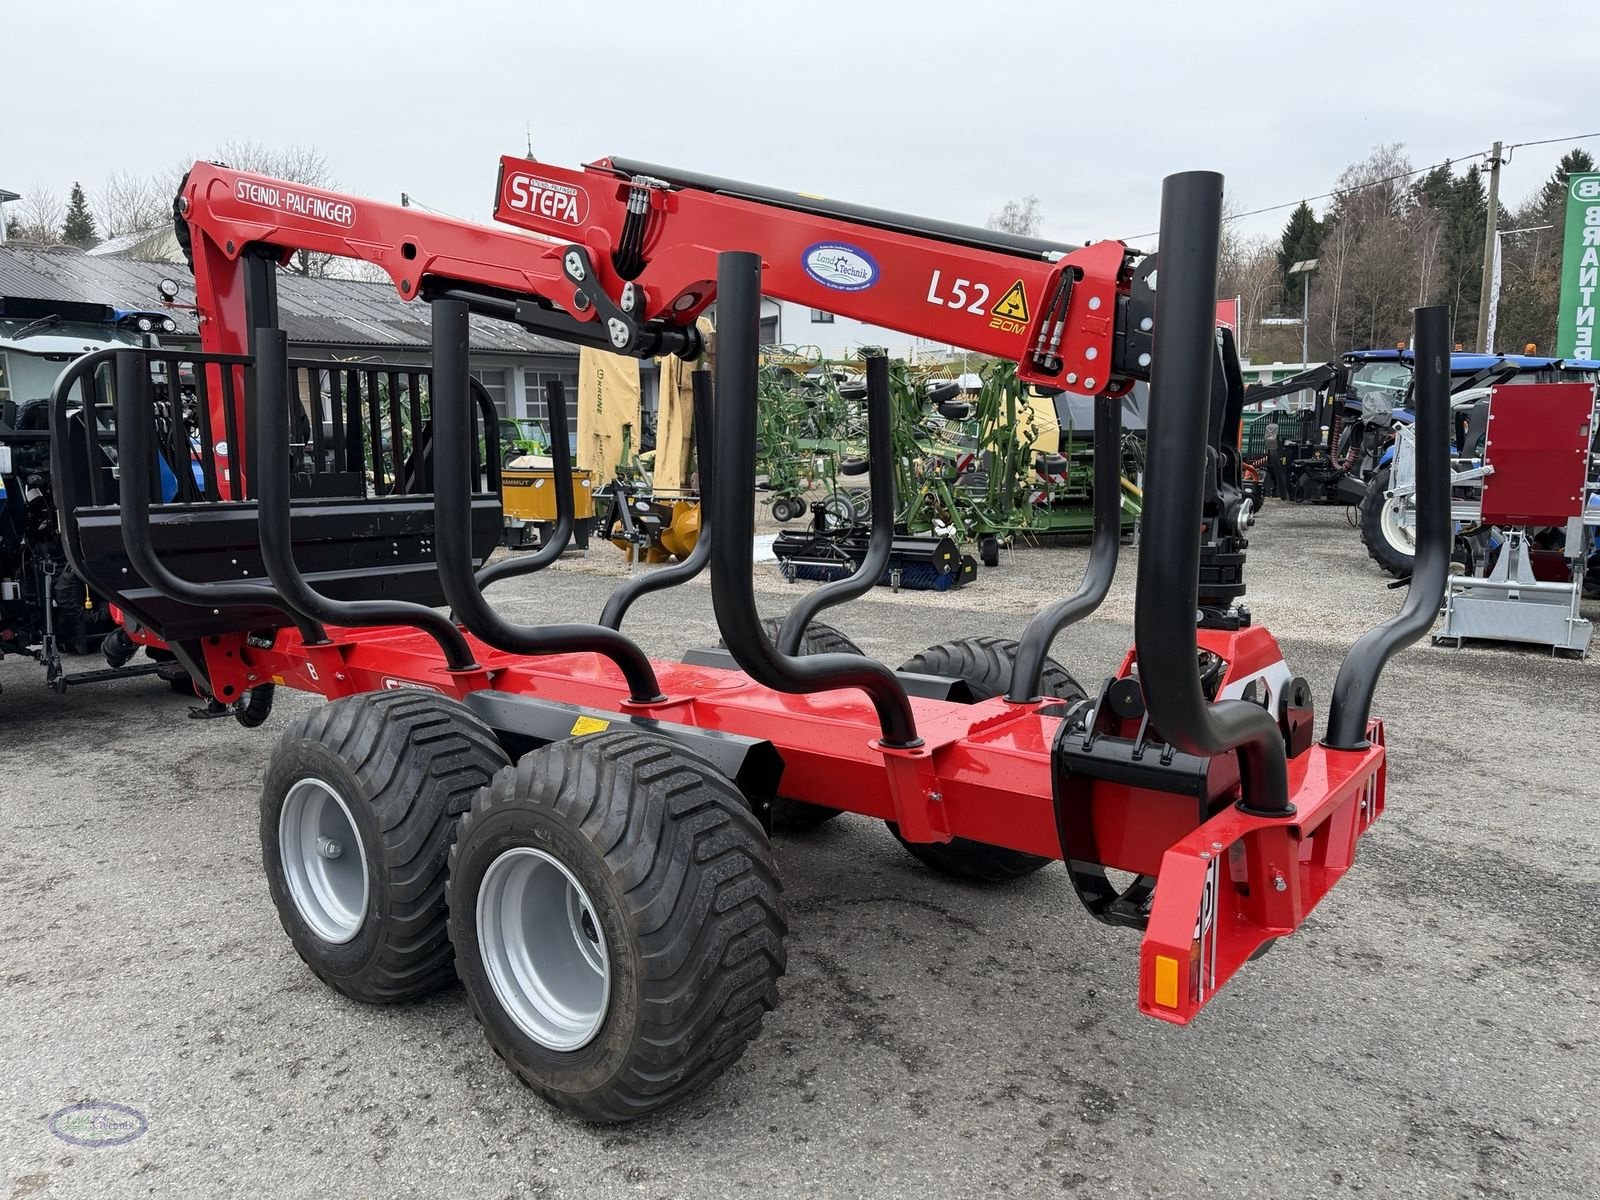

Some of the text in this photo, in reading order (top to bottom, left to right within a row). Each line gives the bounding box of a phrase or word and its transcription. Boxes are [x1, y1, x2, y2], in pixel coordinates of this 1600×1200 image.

[237, 182, 352, 225] STEINDL-PALFINGER
[510, 176, 579, 223] STEPA
[816, 252, 836, 265] Land
[839, 264, 868, 279] Technik
[926, 269, 990, 316] L52
[306, 662, 320, 681] B
